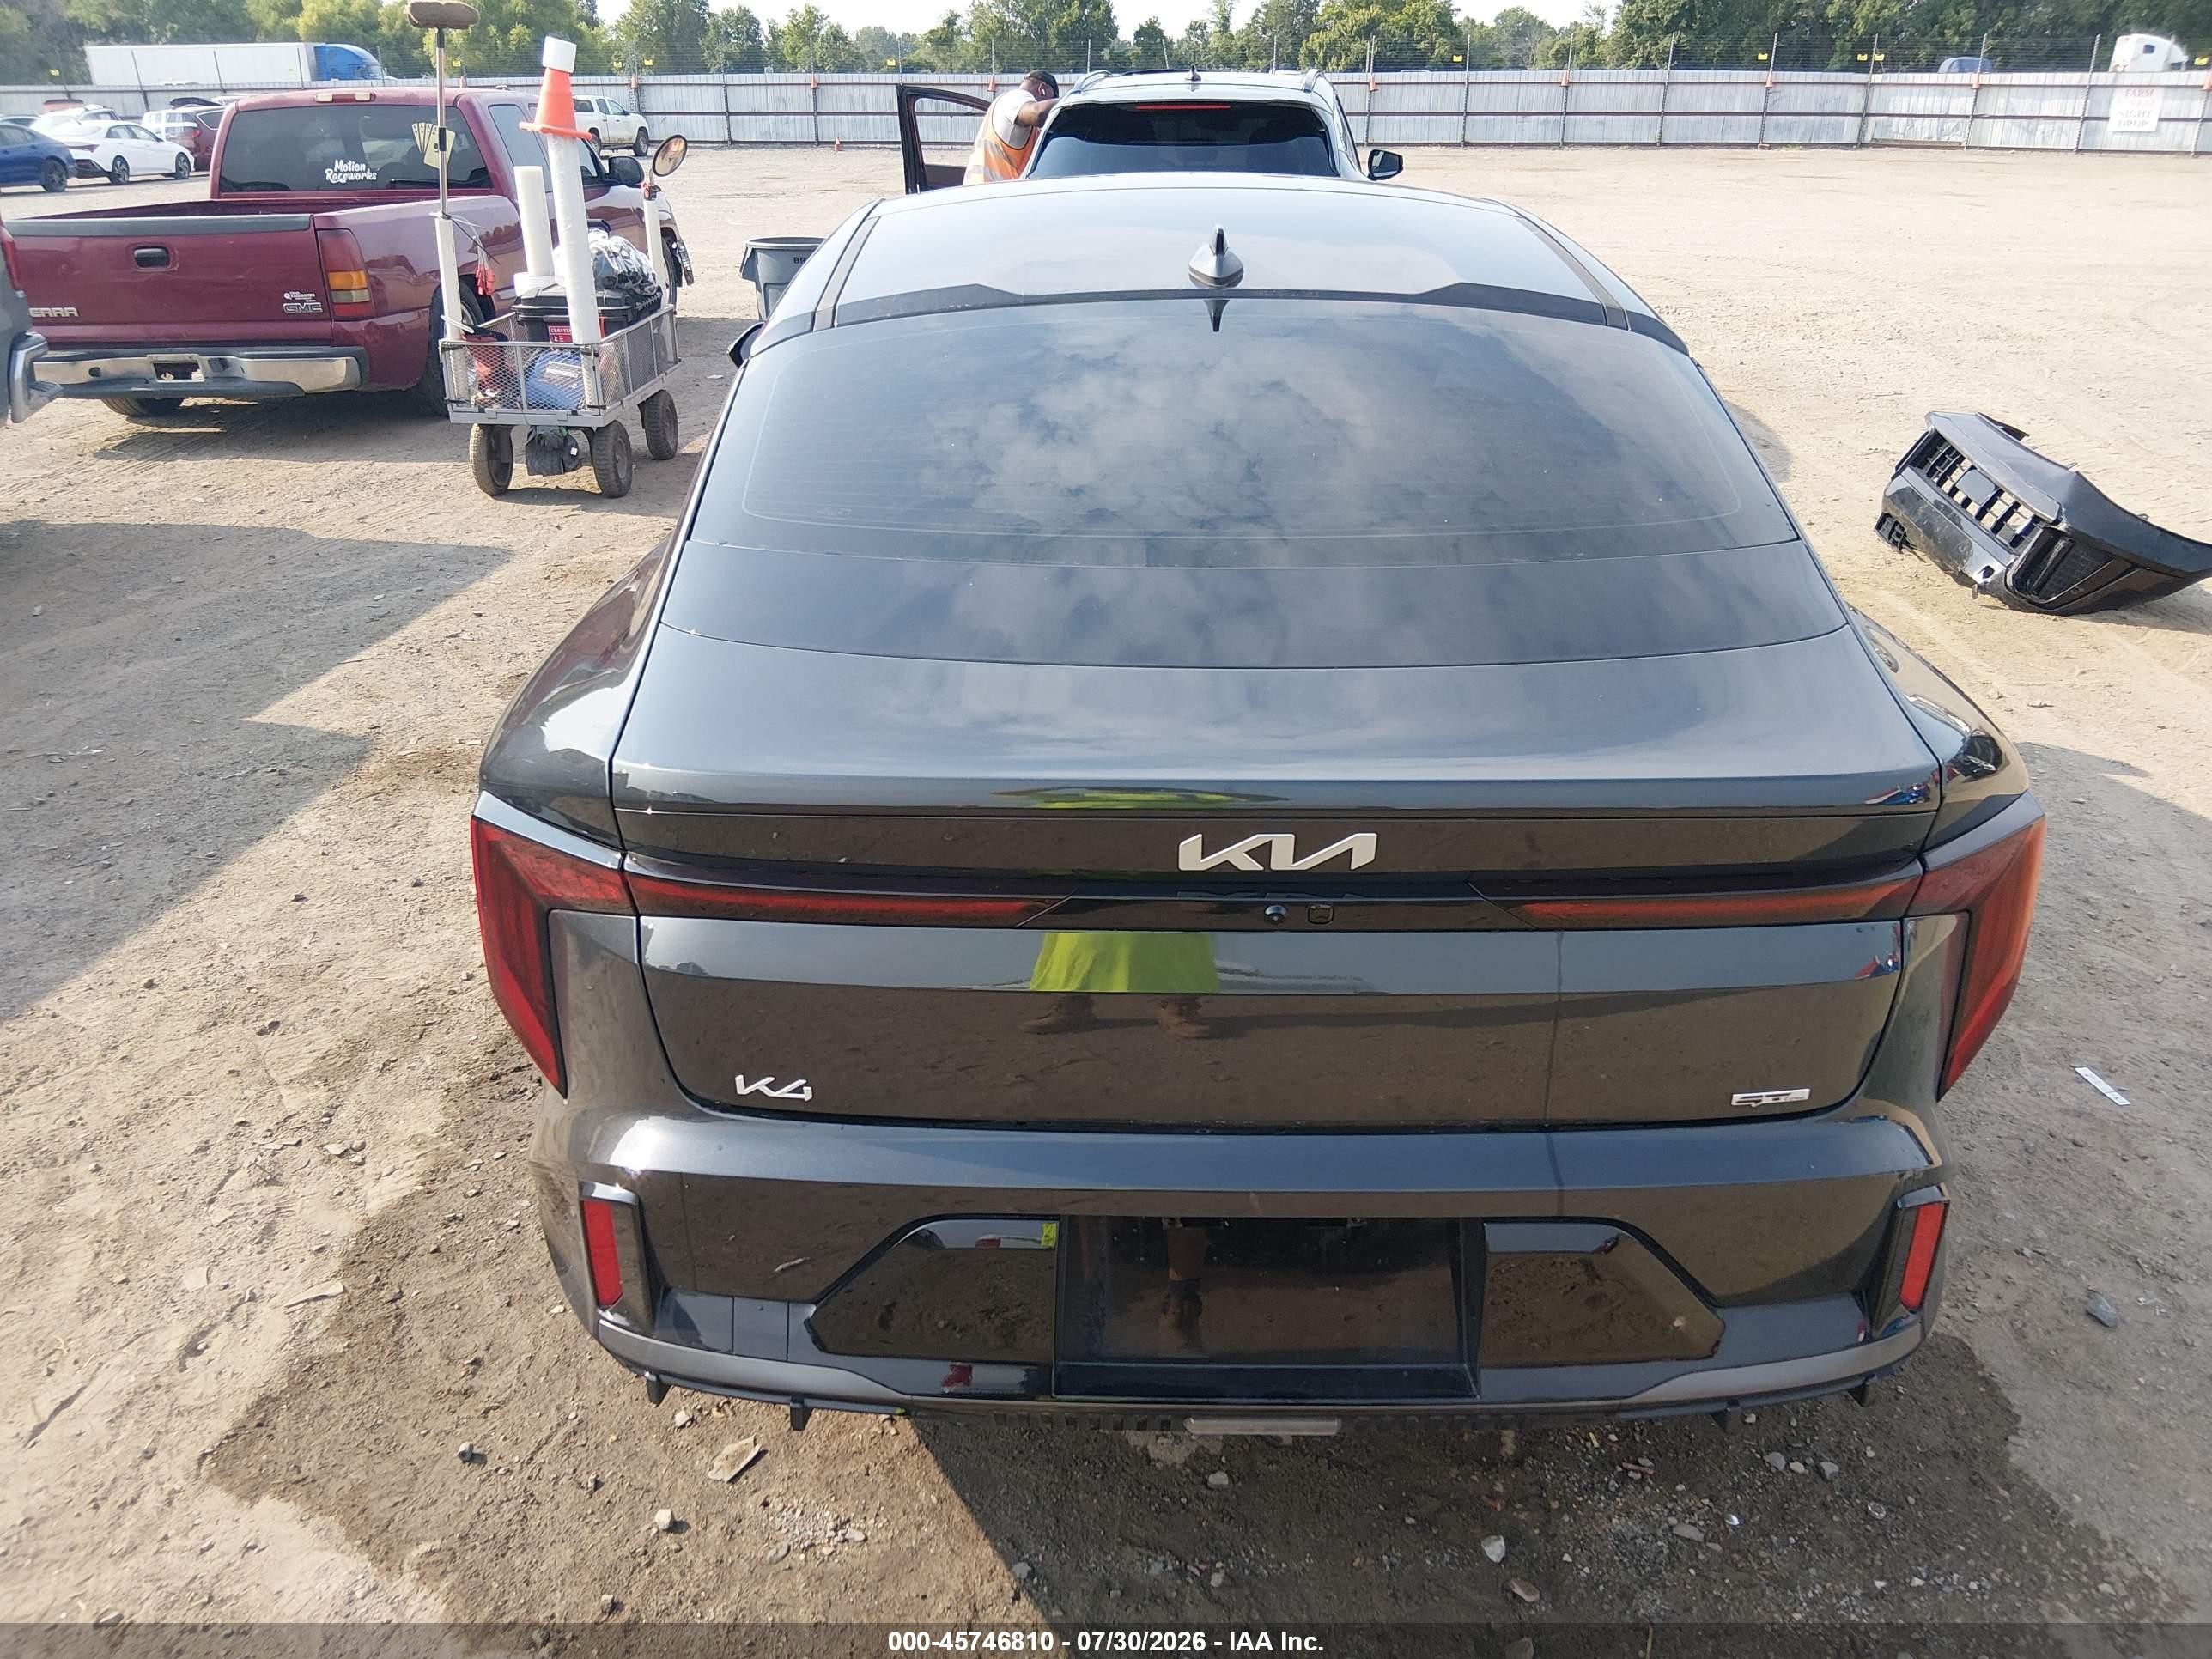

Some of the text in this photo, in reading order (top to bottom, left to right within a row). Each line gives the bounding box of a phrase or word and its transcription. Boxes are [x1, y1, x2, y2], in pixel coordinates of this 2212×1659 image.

[334, 160, 366, 172] Motion
[325, 167, 377, 183] Raceworks
[283, 302, 323, 313] GMC
[735, 1074, 813, 1101] K4
